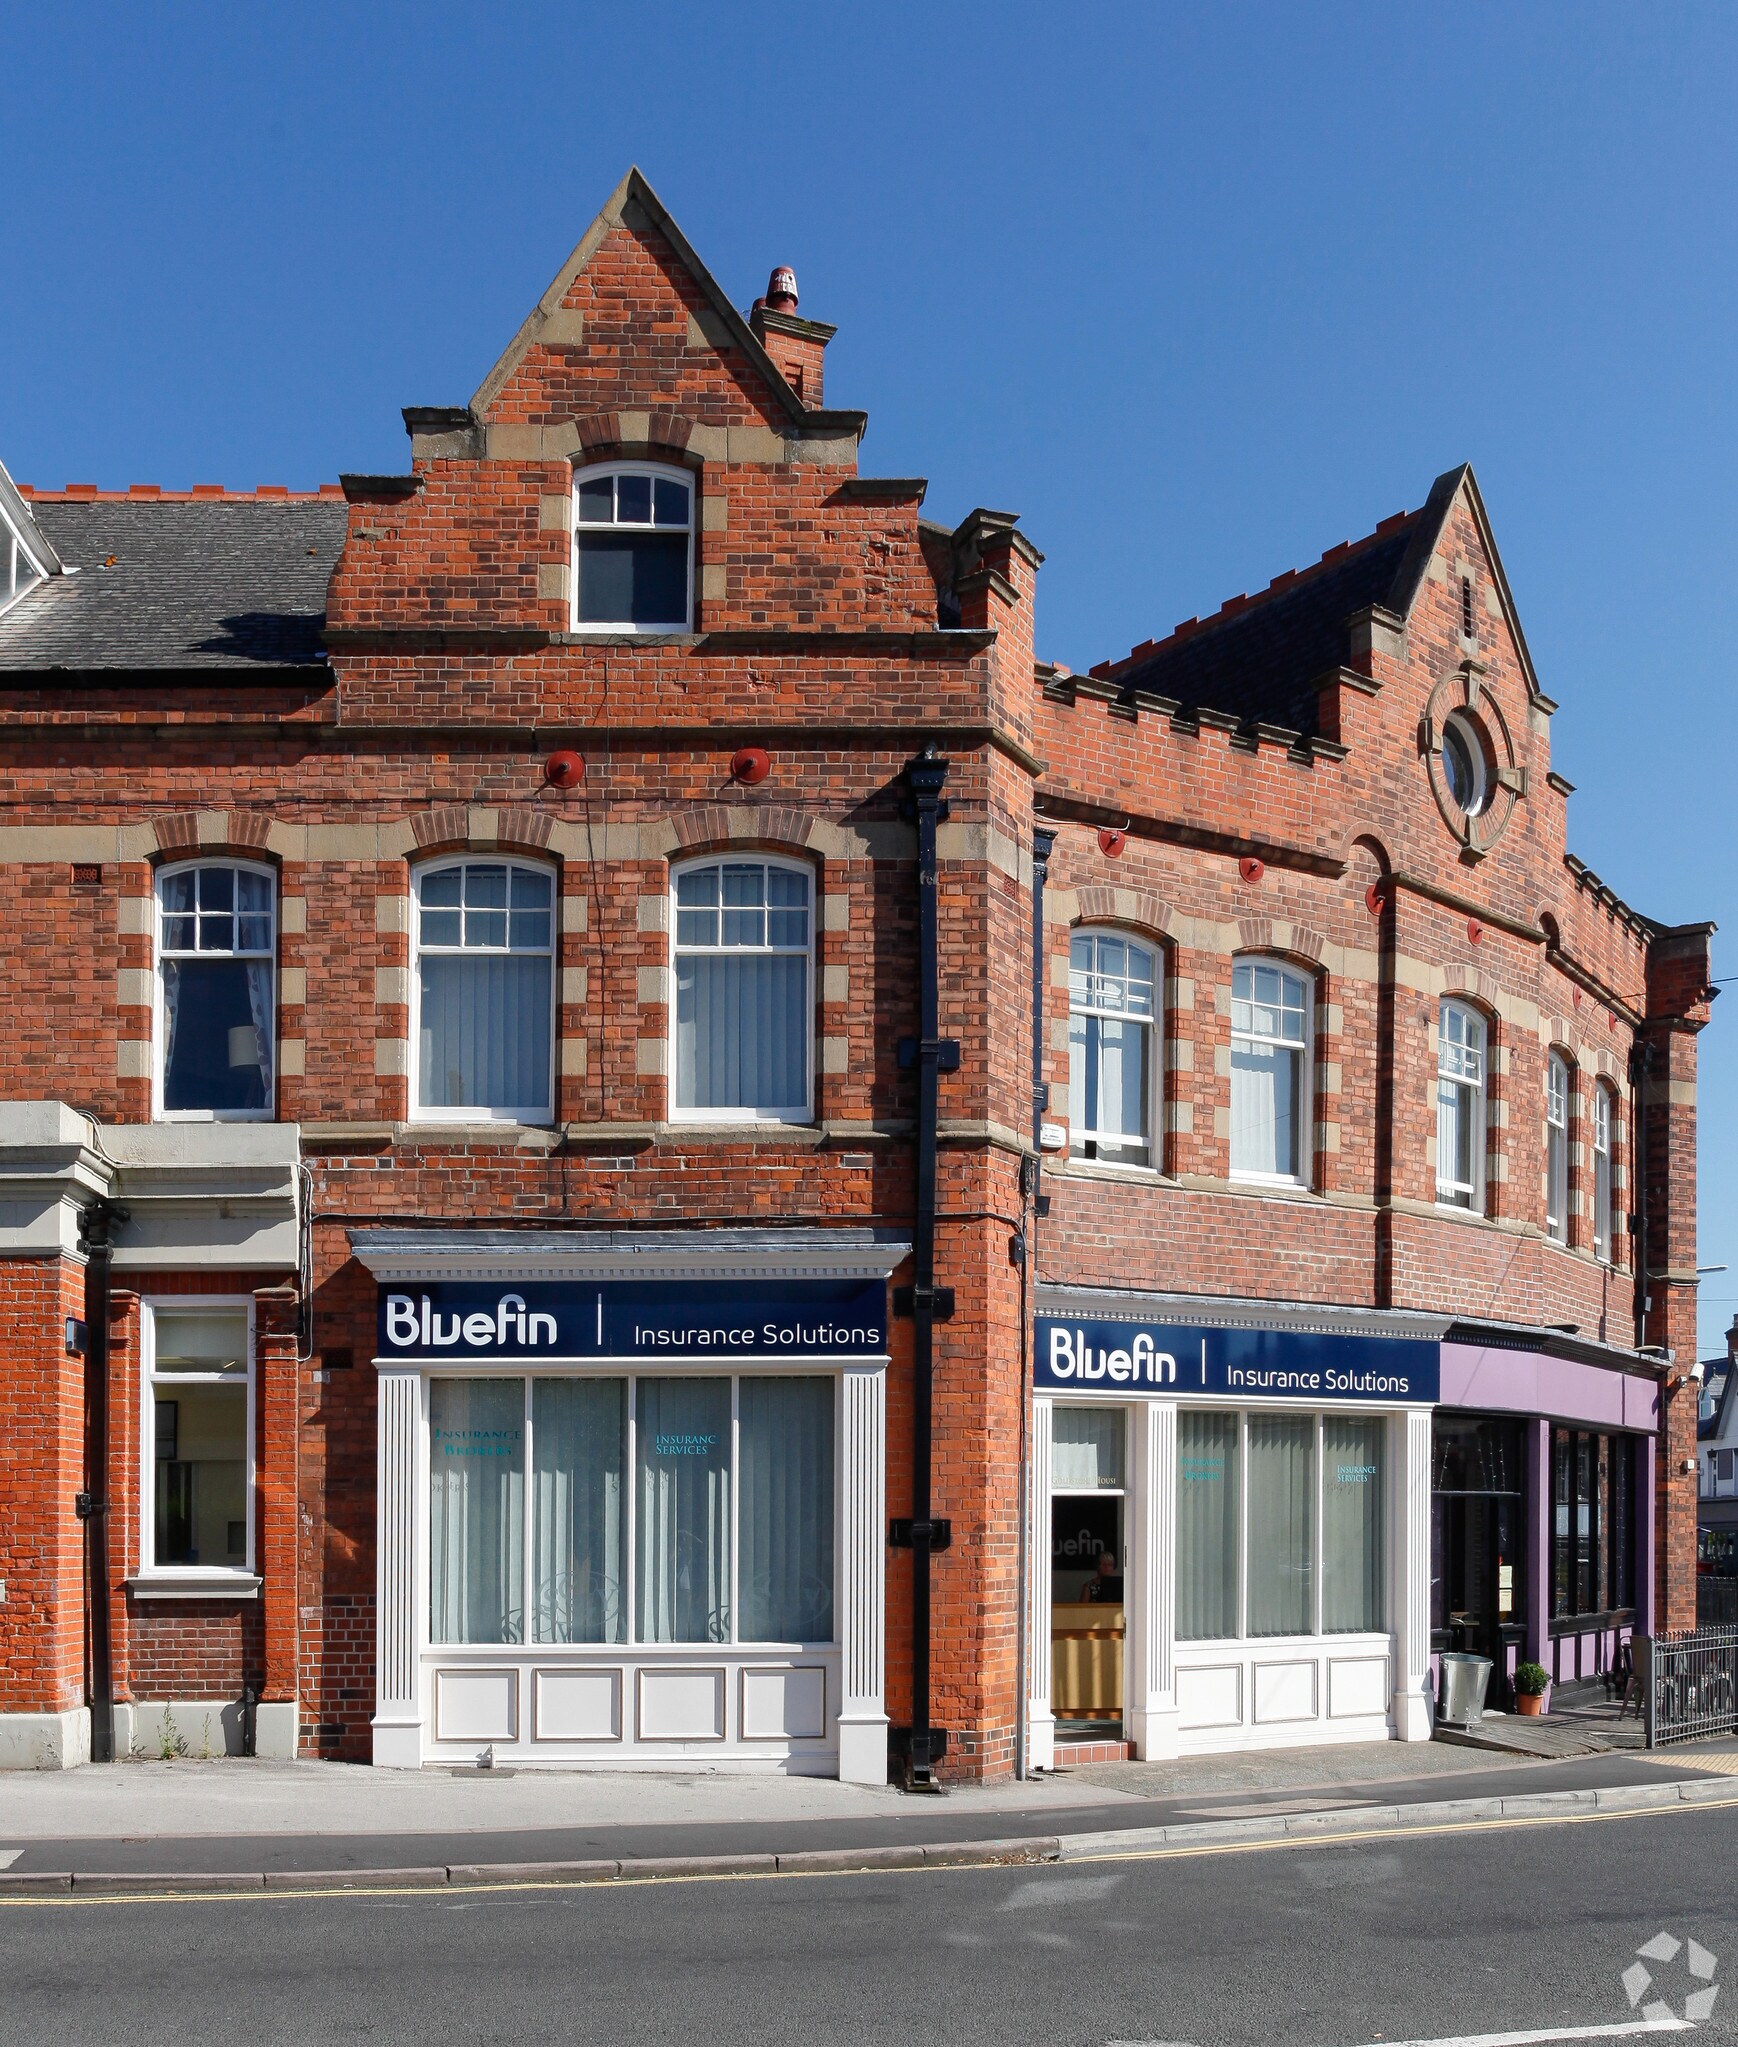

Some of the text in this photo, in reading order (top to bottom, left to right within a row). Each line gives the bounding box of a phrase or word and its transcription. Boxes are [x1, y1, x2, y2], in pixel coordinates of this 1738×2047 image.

[386, 1294, 880, 1347] Bluefin Insurance Solutions
[1049, 1327, 1409, 1393] Bluefin Insurance Solutions
[655, 1444, 707, 1456] SERVICES
[1337, 1464, 1377, 1474] INSURANCE
[1337, 1473, 1368, 1483] SERVICES
